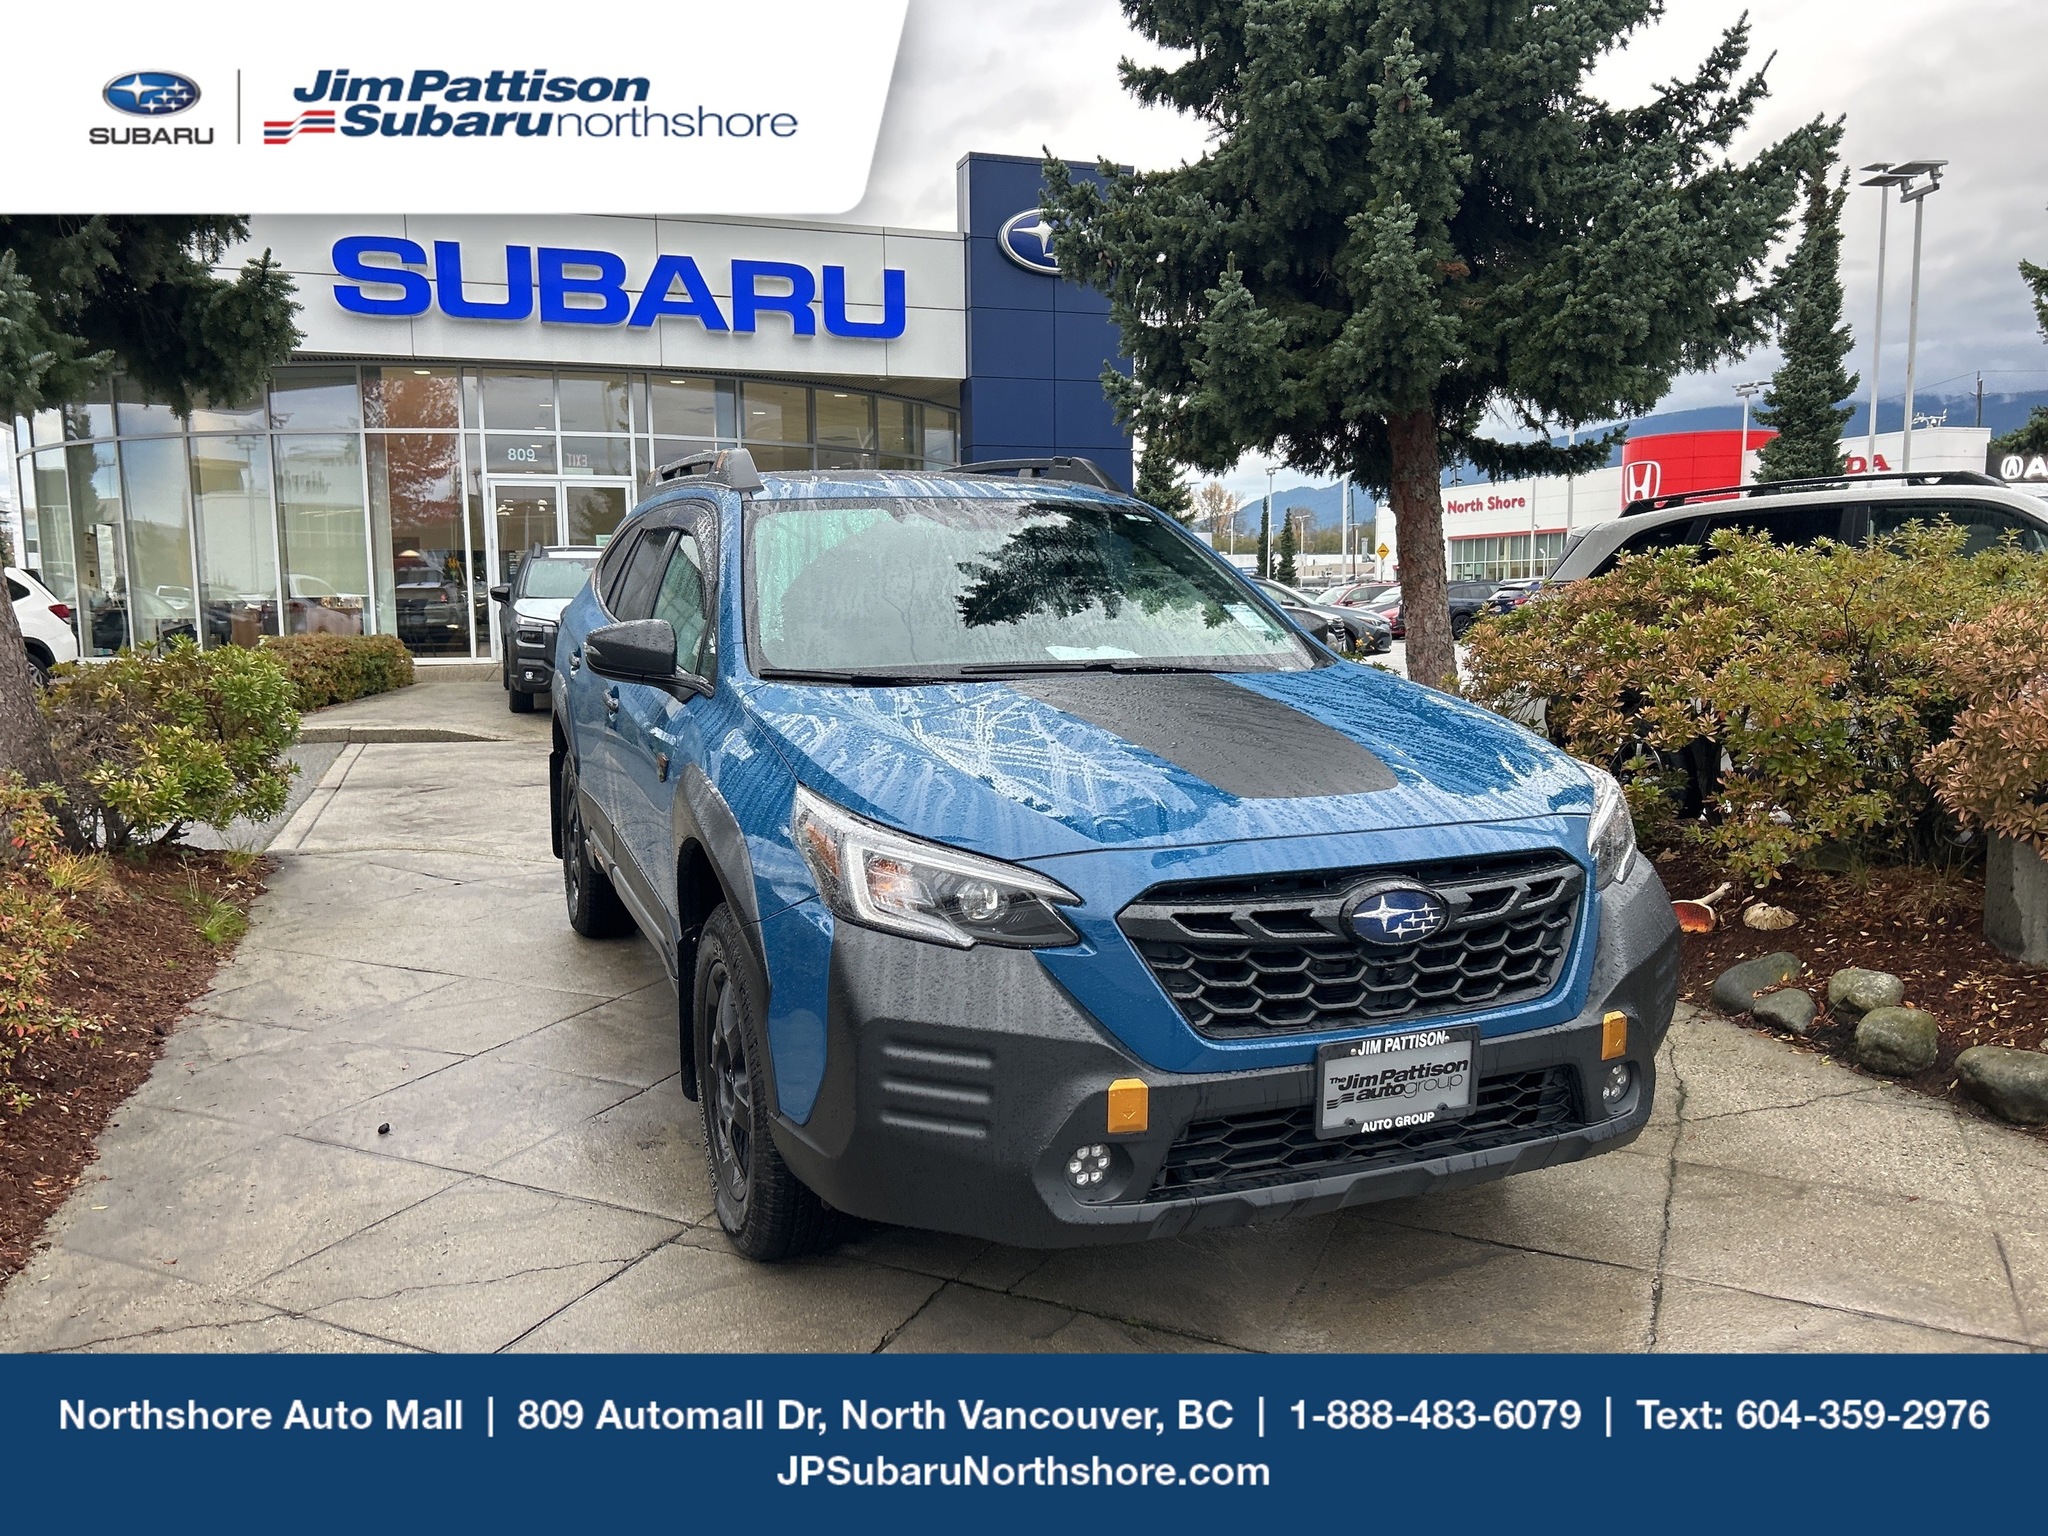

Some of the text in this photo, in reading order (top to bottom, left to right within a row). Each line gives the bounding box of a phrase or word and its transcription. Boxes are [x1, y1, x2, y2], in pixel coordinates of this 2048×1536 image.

[332, 236, 906, 340] SUBARU
[507, 448, 535, 461] 809
[1447, 496, 1525, 514] North Shore
[1357, 1030, 1446, 1056] JIM PATTISON
[1338, 1074, 1379, 1091] Jim
[1379, 1059, 1469, 1085] Pattison
[1361, 1112, 1435, 1133] AUTO GROUP
